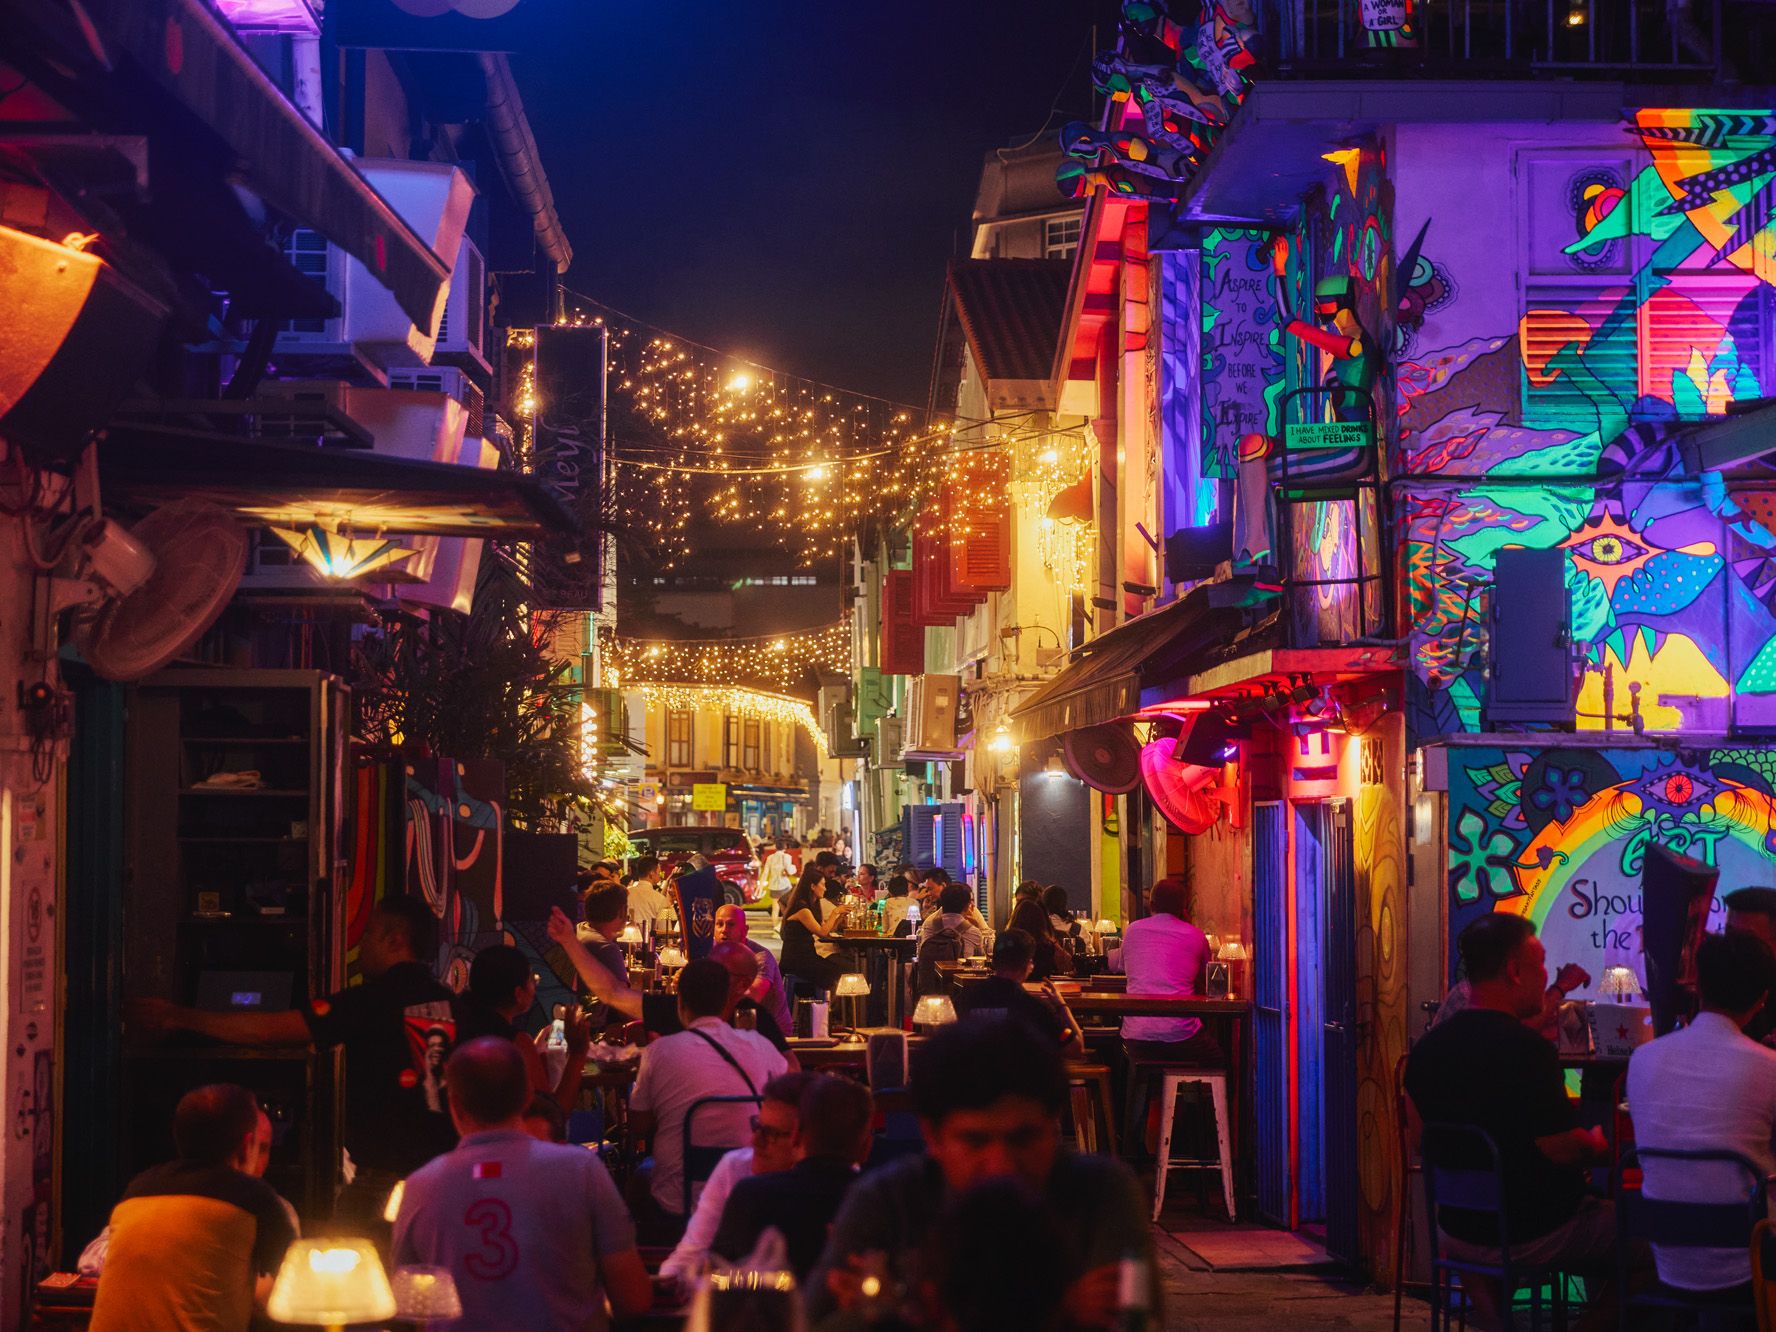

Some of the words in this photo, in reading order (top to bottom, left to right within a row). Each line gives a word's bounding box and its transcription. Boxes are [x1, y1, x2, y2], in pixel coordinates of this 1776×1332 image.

[1377, 16, 1399, 25] GIRL
[1208, 268, 1265, 304] ASPIRE
[1235, 302, 1247, 313] TO
[1214, 318, 1269, 359] INSPIRE
[1227, 362, 1256, 378] BEFORE
[1235, 381, 1247, 394] WE
[1296, 426, 1315, 435] HAVE
[1318, 425, 1340, 434] MIXED
[1341, 424, 1369, 433] DRINKS
[1298, 435, 1321, 444] ABOUT
[1323, 433, 1361, 444] FEELINGS
[1622, 825, 1729, 877] ART
[1568, 878, 1644, 920] Shou
[1591, 918, 1631, 950] the
[464, 1198, 519, 1281] 3
